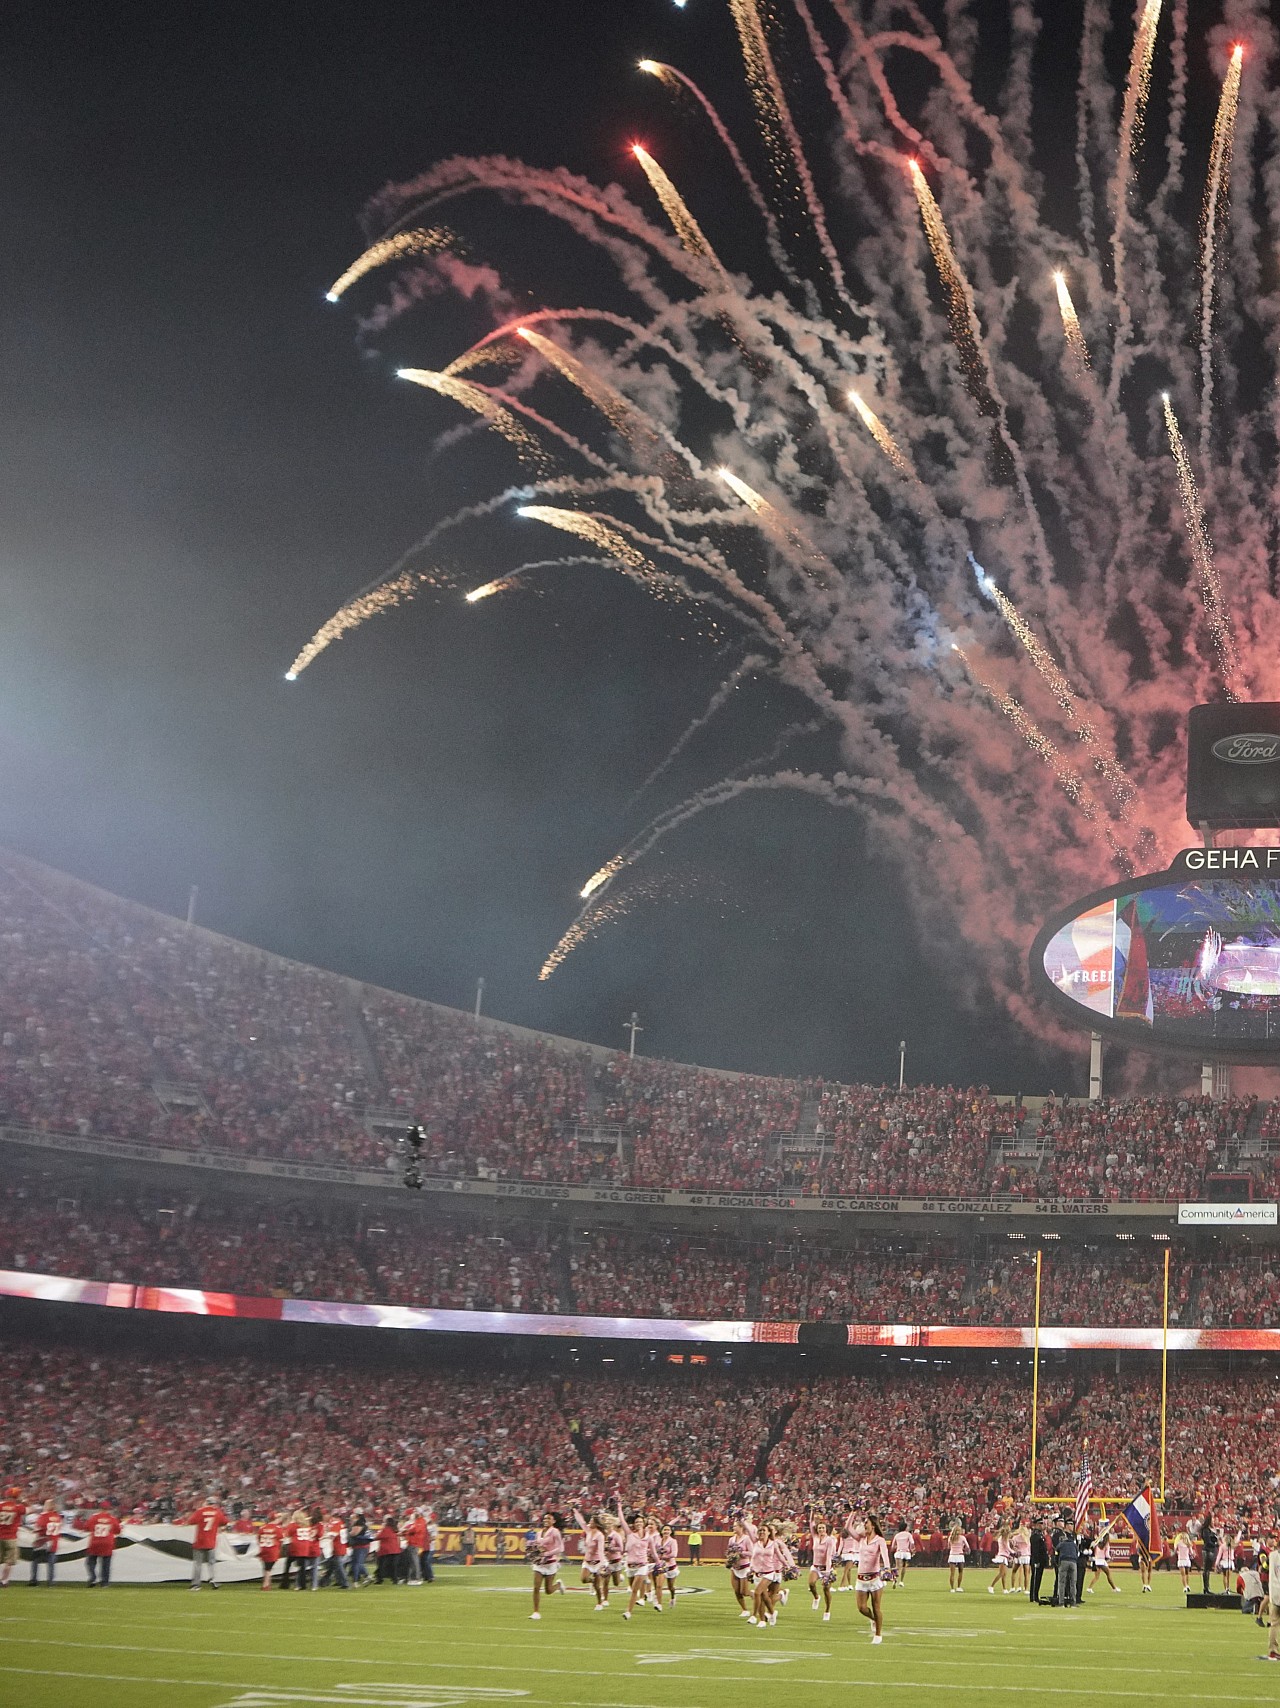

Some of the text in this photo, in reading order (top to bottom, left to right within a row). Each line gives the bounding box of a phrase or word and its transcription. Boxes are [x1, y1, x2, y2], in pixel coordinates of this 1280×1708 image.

[1228, 738, 1278, 758] Ford
[1185, 849, 1259, 870] GEHA
[520, 1186, 570, 1199] HOLMES
[609, 1191, 622, 1202] G.
[624, 1193, 666, 1204] GREEN
[704, 1196, 716, 1205] T.
[836, 1200, 848, 1210] C.
[850, 1201, 899, 1211] CARSON
[922, 1203, 1013, 1213] 88 T. GONZALEZ
[1035, 1204, 1109, 1214] 54 B. WATERS
[1180, 1207, 1275, 1220] CommunityAmerica
[203, 1516, 215, 1532] 7
